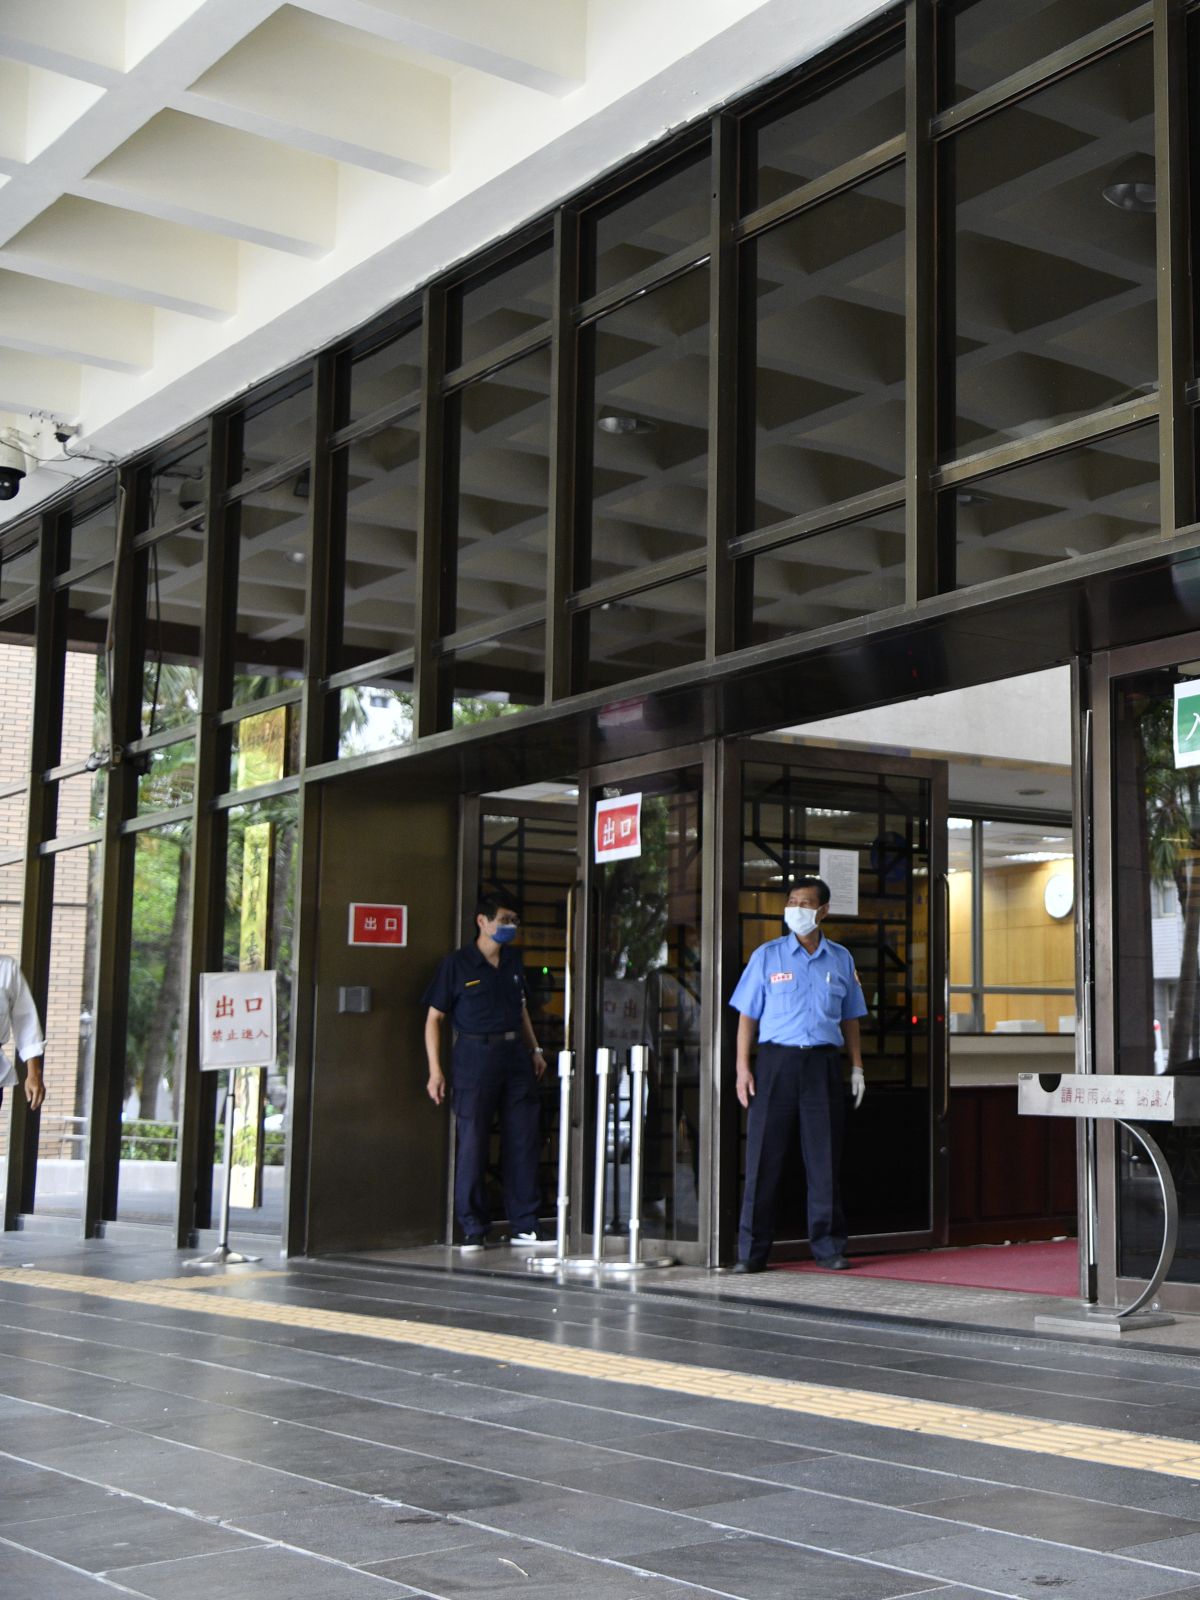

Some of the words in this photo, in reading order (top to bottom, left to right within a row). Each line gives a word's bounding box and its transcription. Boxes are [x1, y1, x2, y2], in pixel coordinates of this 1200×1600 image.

[603, 816, 632, 847] 出口
[365, 916, 398, 931] 出口
[216, 995, 263, 1018] 出口
[211, 1029, 269, 1042] 禁止進入
